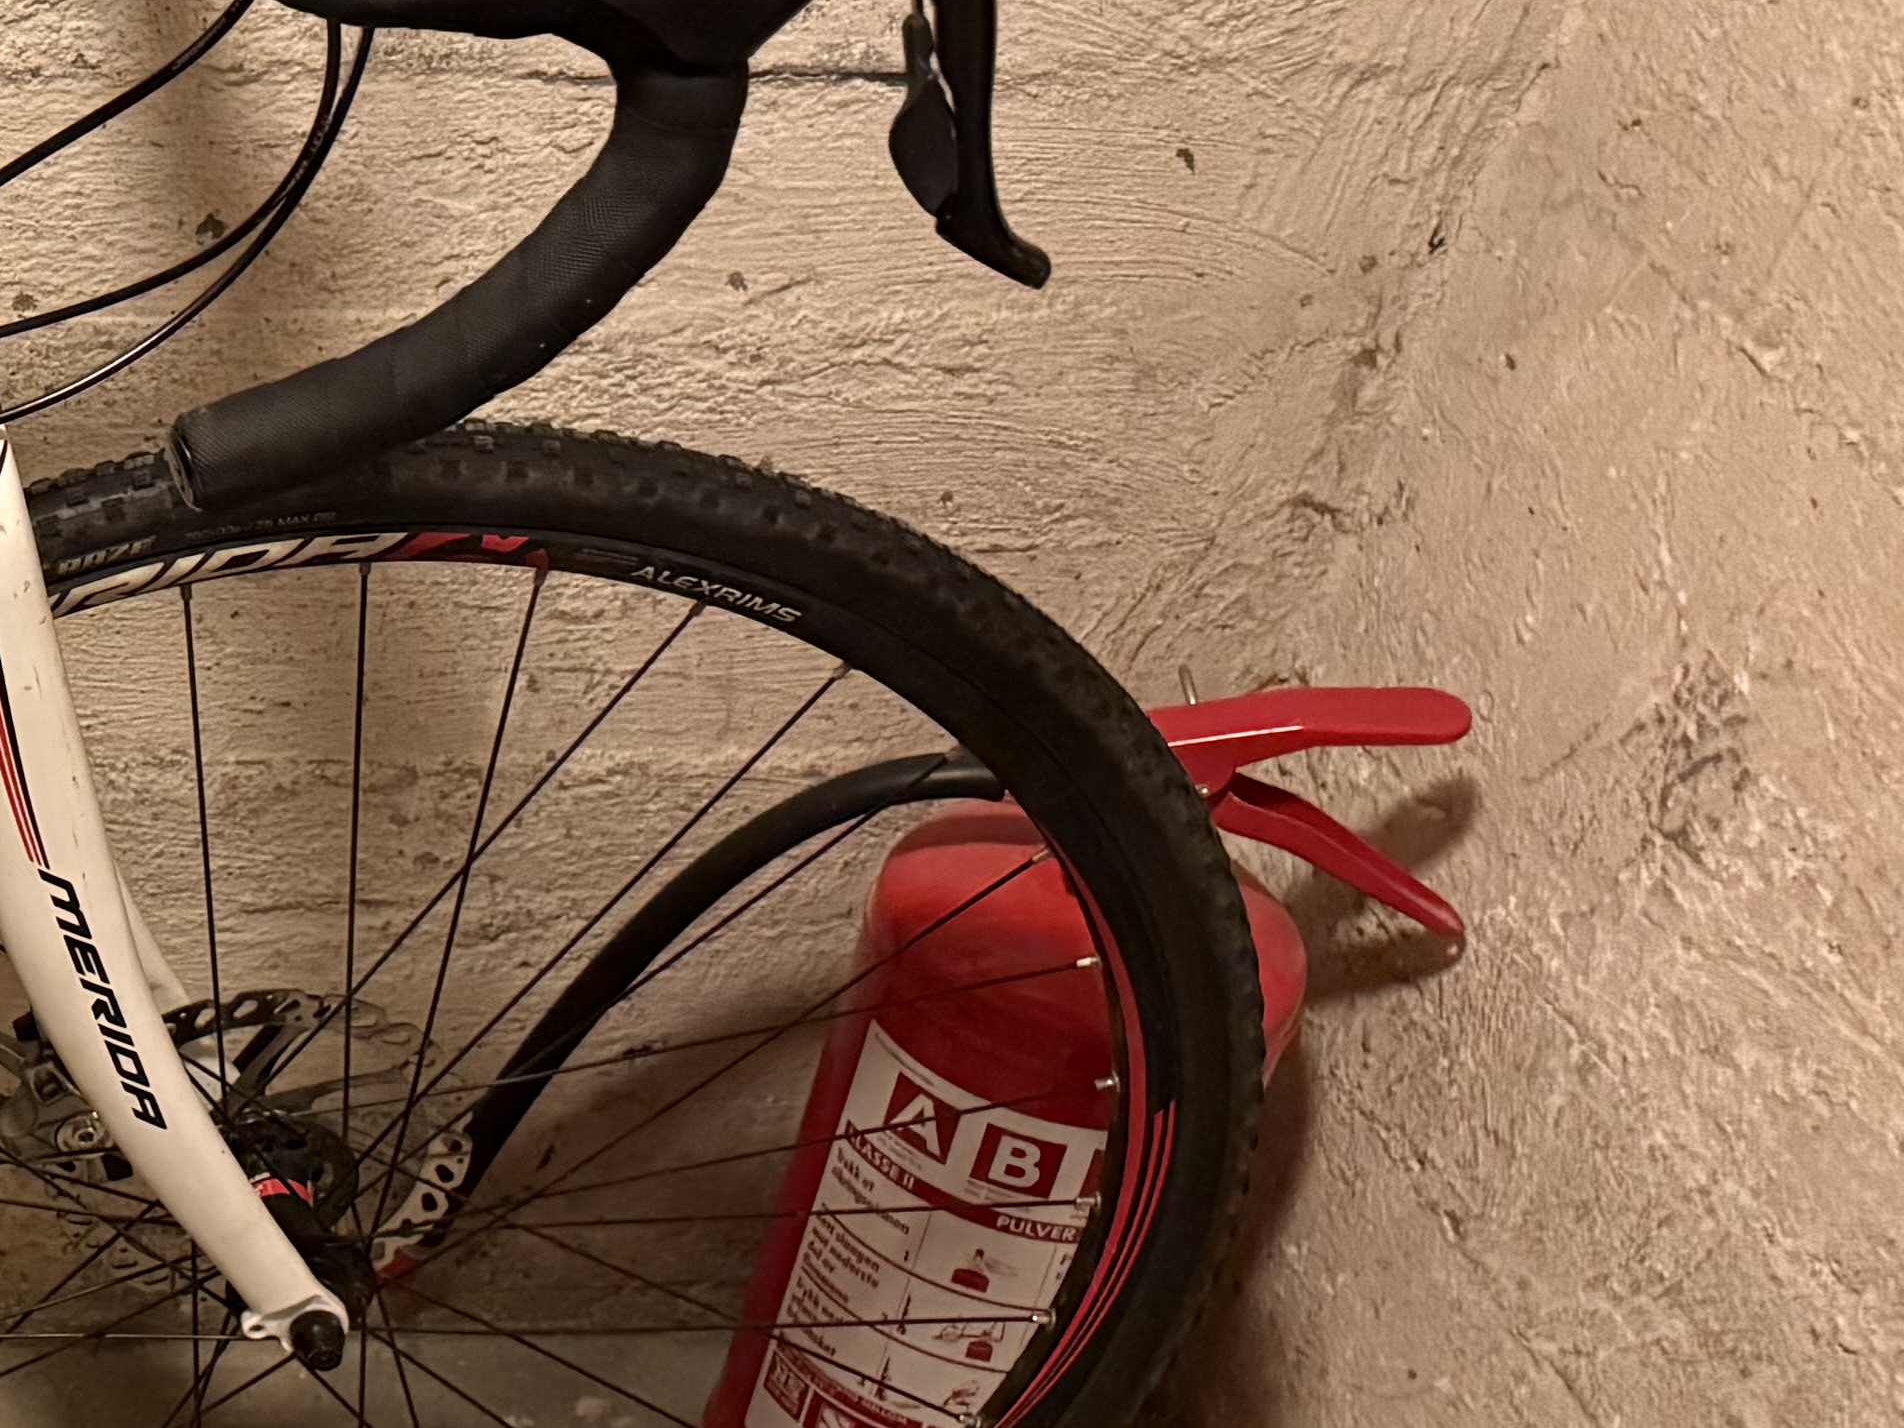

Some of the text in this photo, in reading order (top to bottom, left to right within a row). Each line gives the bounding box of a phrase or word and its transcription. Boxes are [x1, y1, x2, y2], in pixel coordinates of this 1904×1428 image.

[631, 566, 802, 622] ALEXRIMS
[39, 869, 169, 1131] MERIDA
[888, 1093, 942, 1159] A
[988, 1135, 1041, 1188] B
